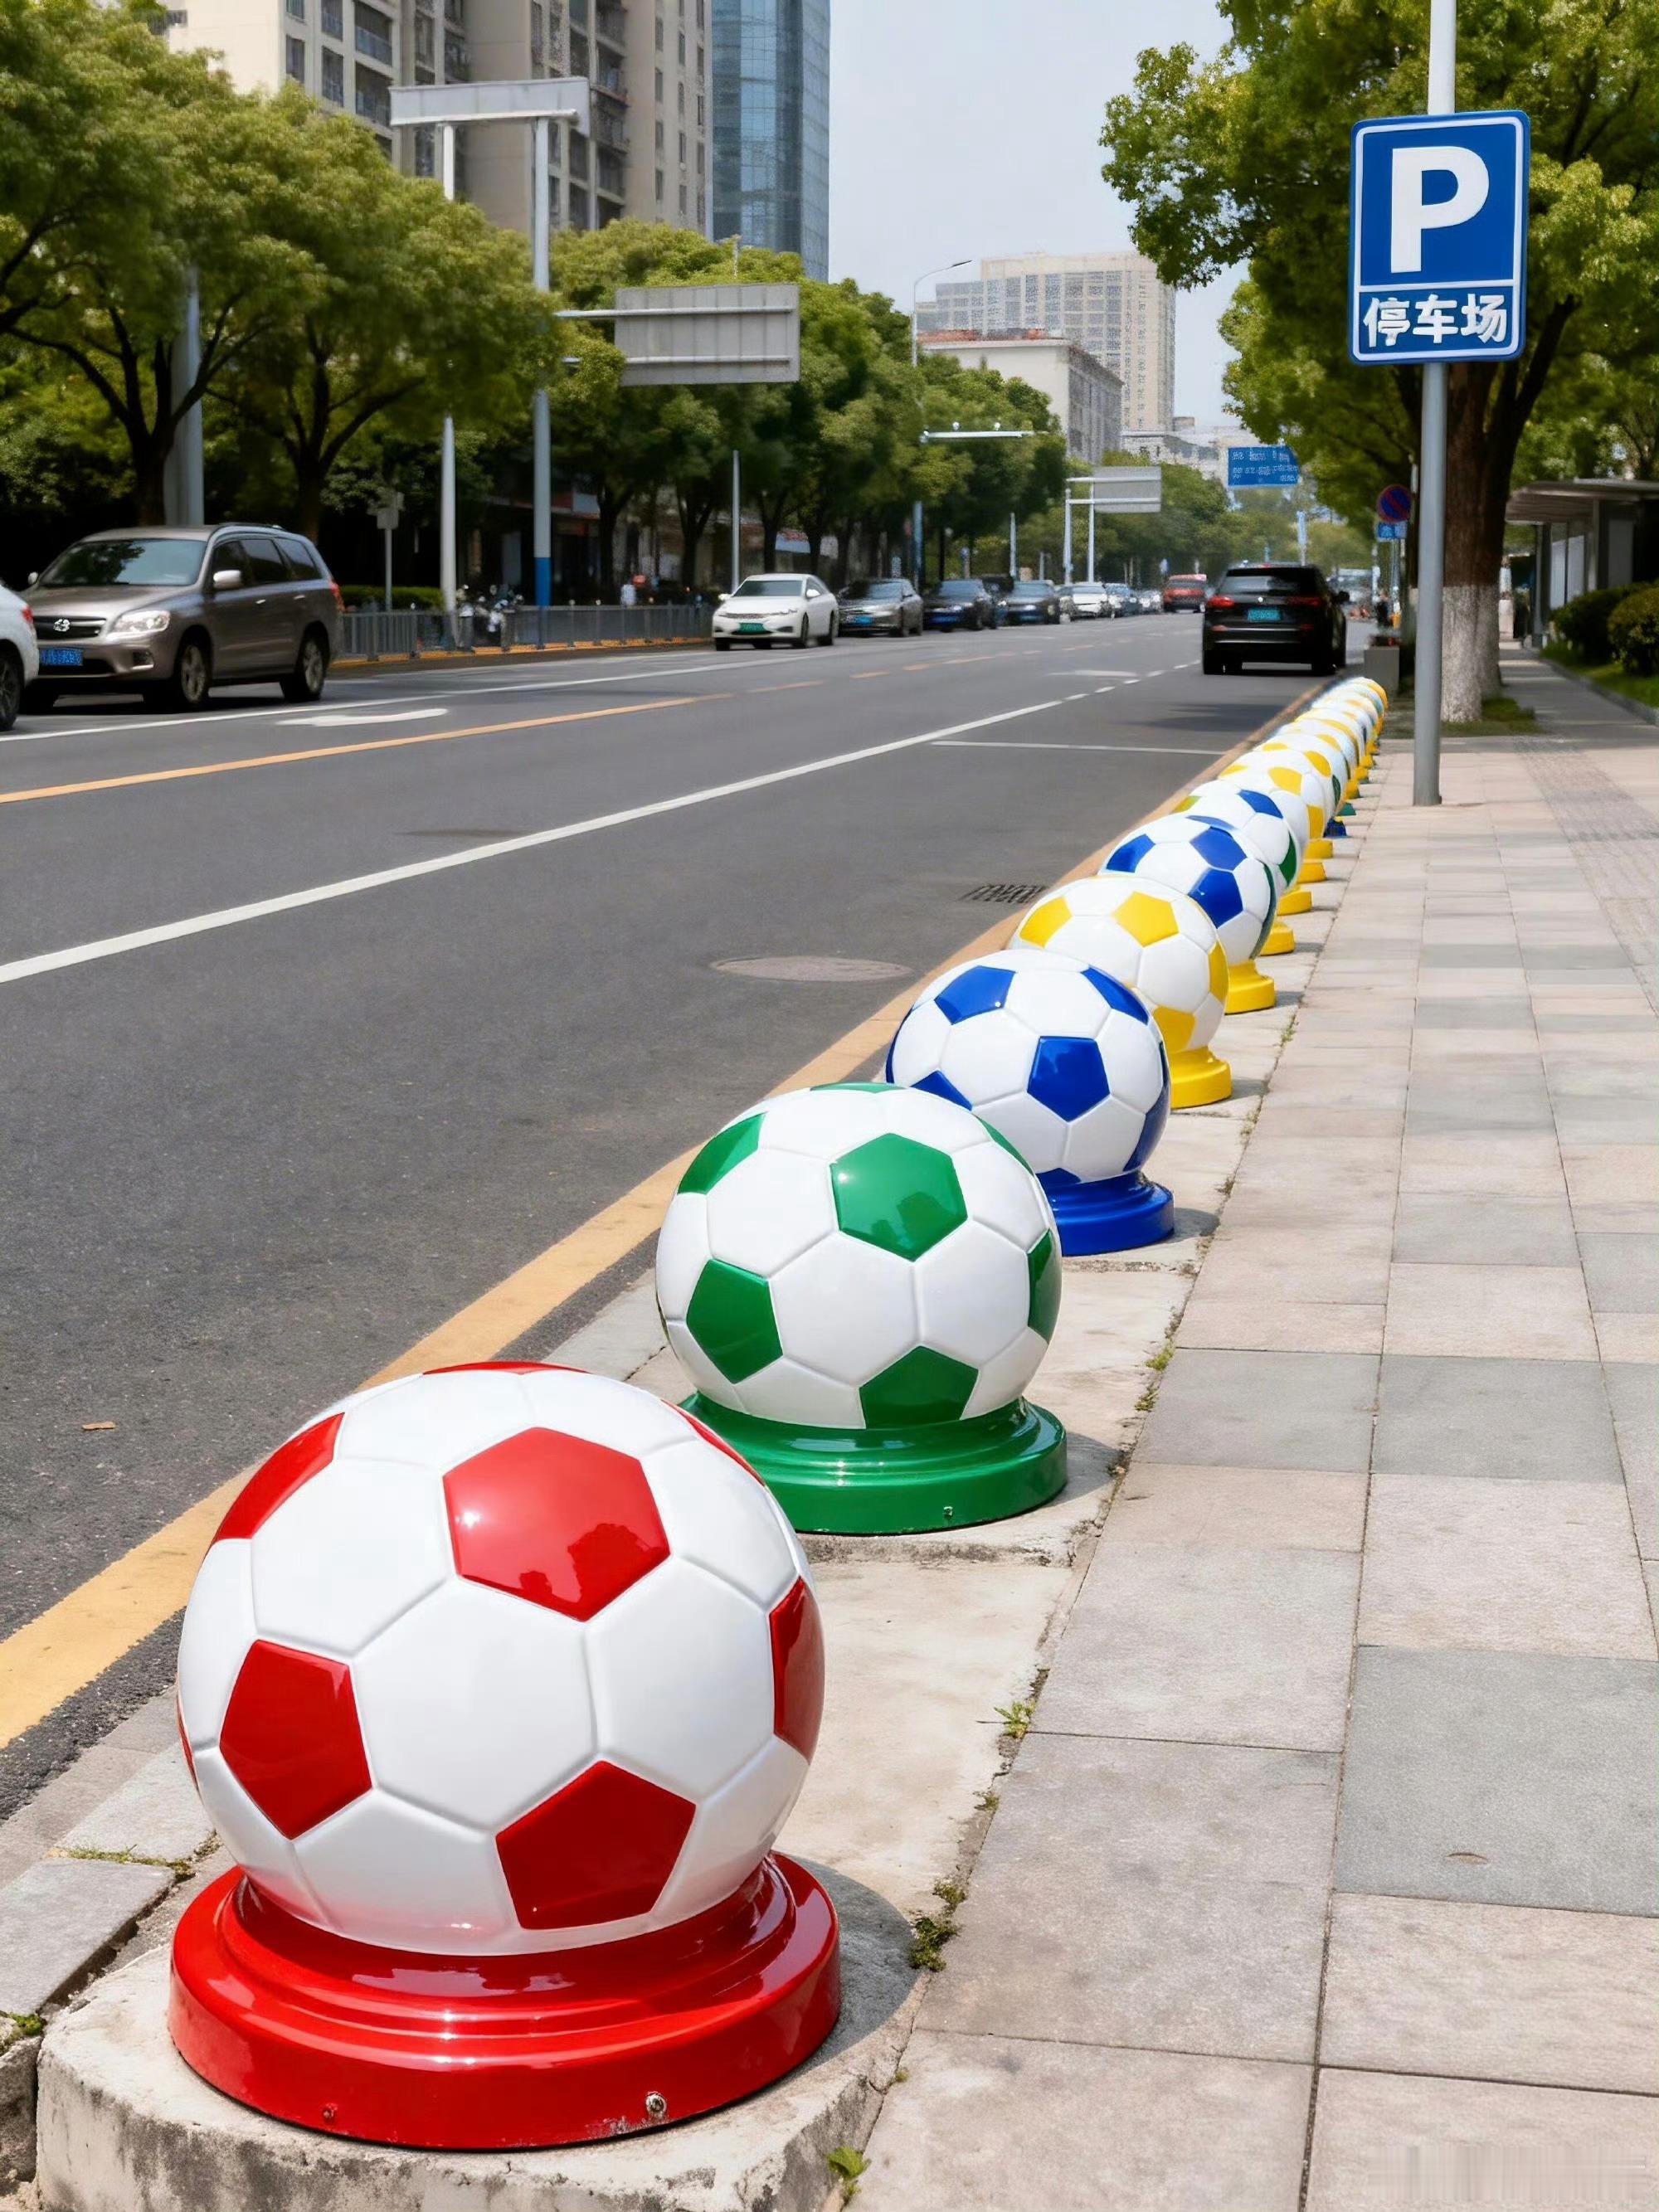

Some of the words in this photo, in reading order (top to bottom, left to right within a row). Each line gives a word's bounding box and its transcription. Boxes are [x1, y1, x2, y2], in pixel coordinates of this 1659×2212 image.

[1391, 146, 1489, 273] P
[1363, 294, 1507, 348] 停车场
